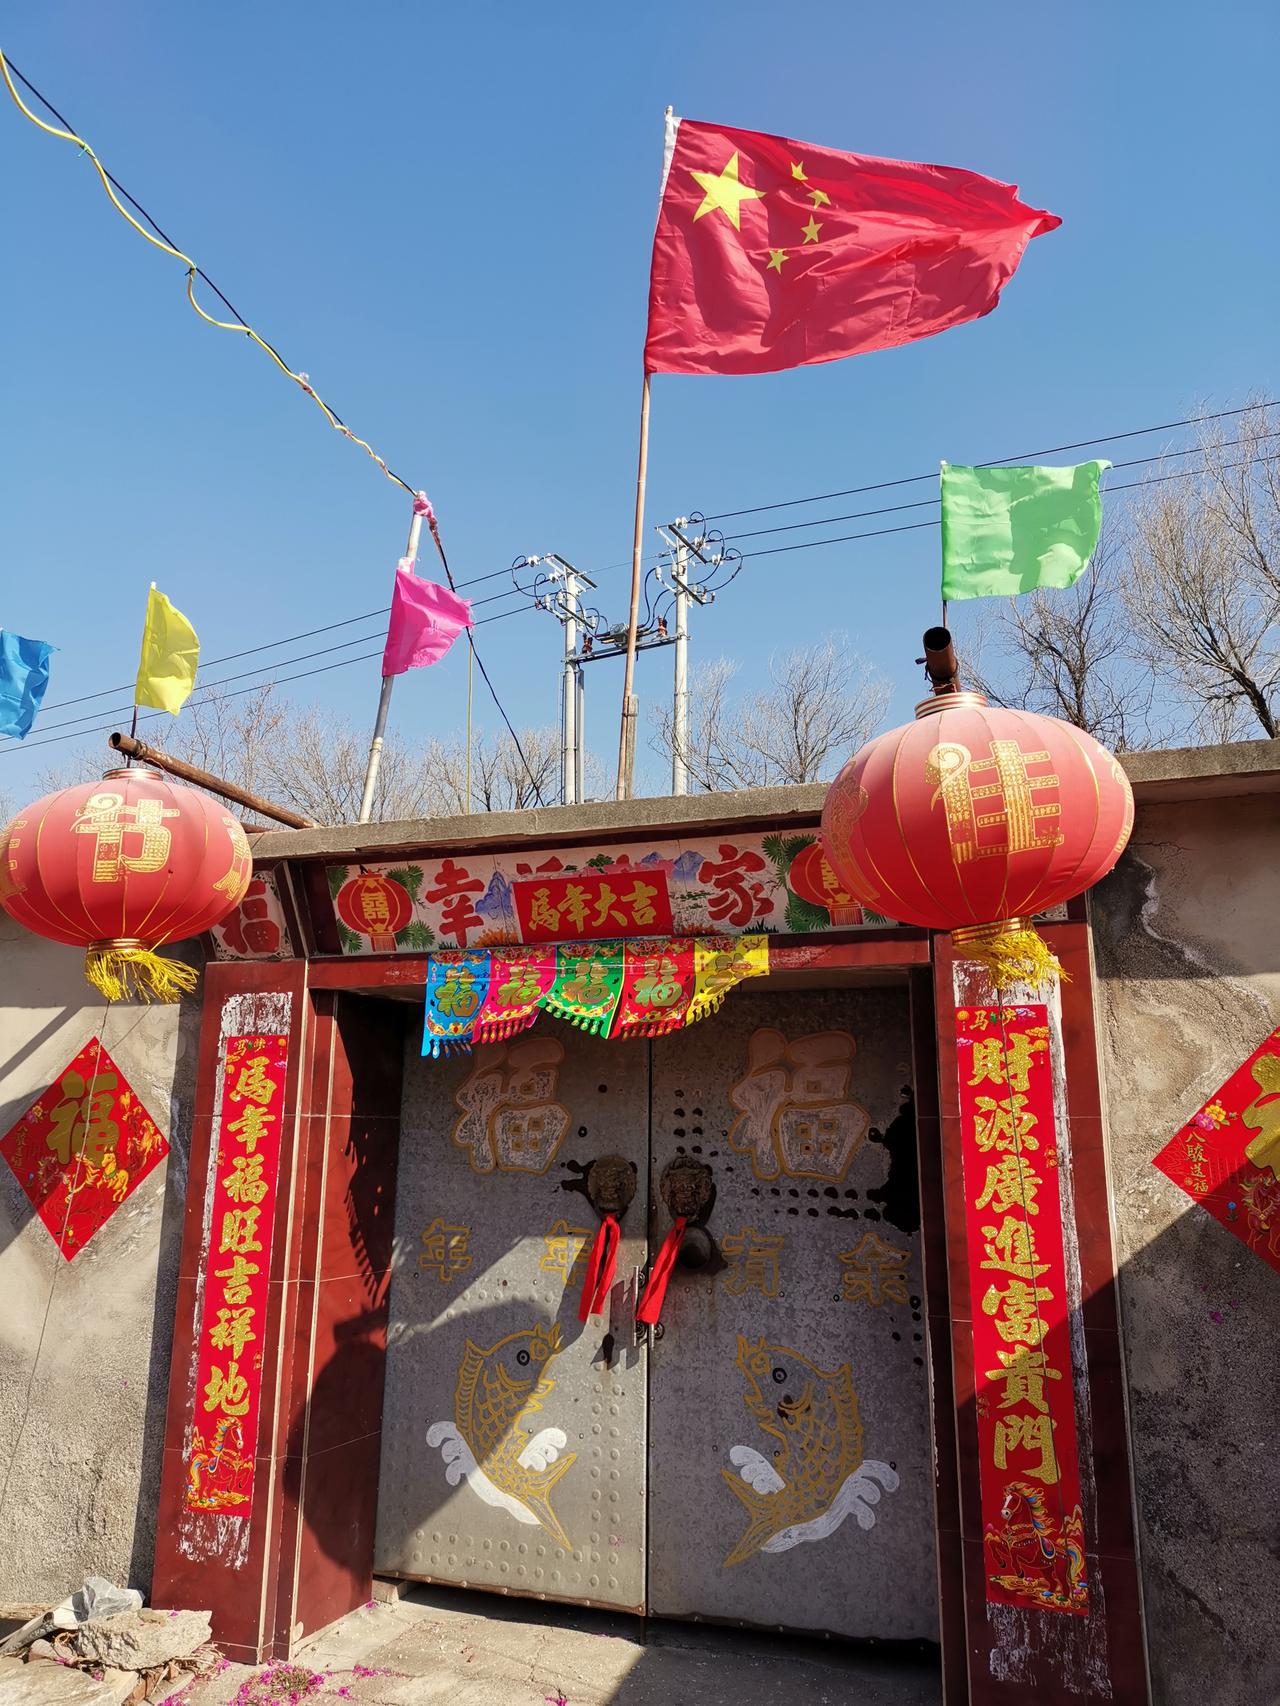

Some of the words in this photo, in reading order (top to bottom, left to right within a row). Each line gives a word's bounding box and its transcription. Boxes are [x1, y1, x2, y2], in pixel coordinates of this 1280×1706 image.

[924, 738, 1064, 864] 佳
[46, 1070, 119, 1167] 福
[728, 1027, 871, 1184] 福
